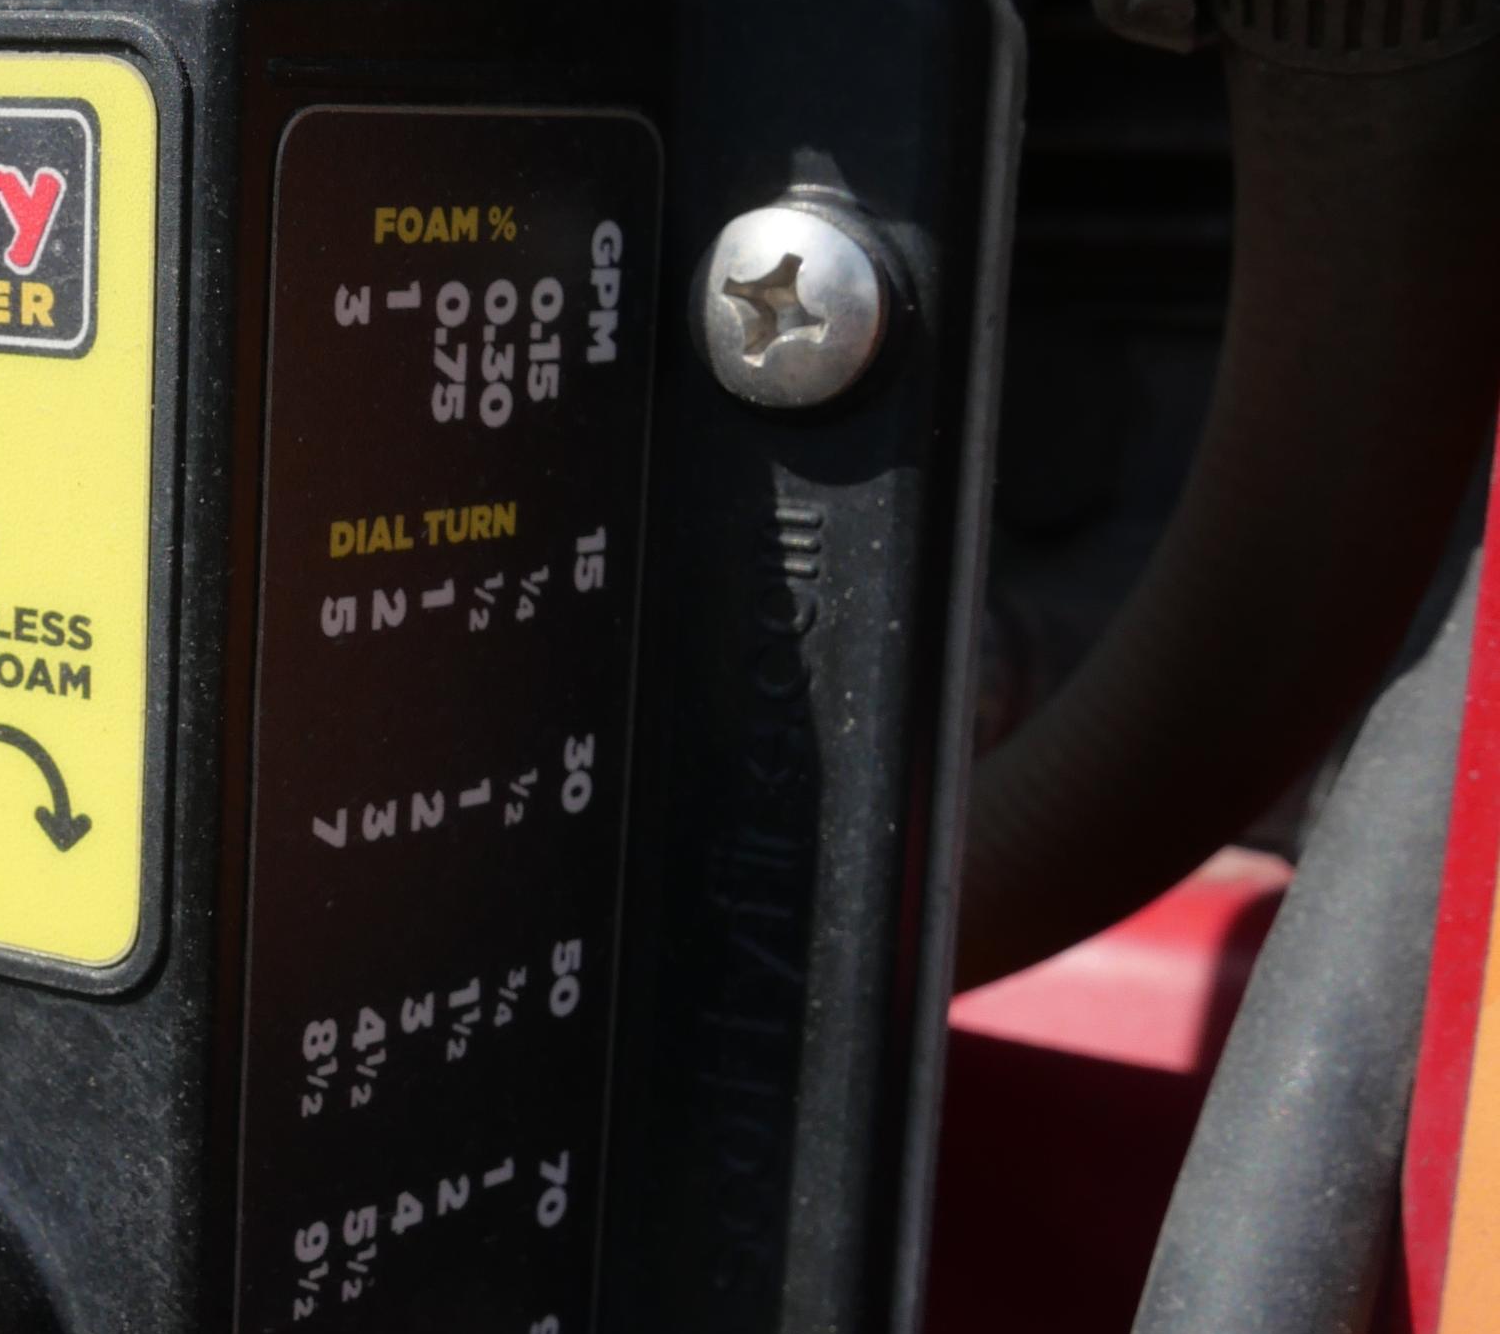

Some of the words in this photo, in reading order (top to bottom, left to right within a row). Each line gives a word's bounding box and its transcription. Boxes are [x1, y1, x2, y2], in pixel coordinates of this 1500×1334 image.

[373, 207, 479, 245] FOAM
[334, 284, 371, 327] 3
[385, 280, 422, 310] 1
[586, 219, 623, 364] GPM
[430, 280, 471, 424] 0.75
[479, 278, 518, 429] 0.30
[526, 276, 564, 402] 0.15
[329, 515, 413, 559] DIAL
[424, 503, 517, 544] TURN
[573, 526, 607, 593] 15
[371, 587, 408, 630] 2
[421, 578, 456, 610] 1
[321, 596, 357, 638] 5
[458, 777, 492, 809] 1
[560, 733, 595, 814] 30
[312, 807, 348, 849] 7
[361, 799, 397, 842] 3
[410, 789, 445, 832] 2
[548, 937, 583, 1017] 50
[401, 991, 435, 1034] 3
[437, 1172, 471, 1215] 2
[483, 1156, 515, 1189] 1
[536, 1150, 570, 1229] 70
[390, 1190, 424, 1235] 4
